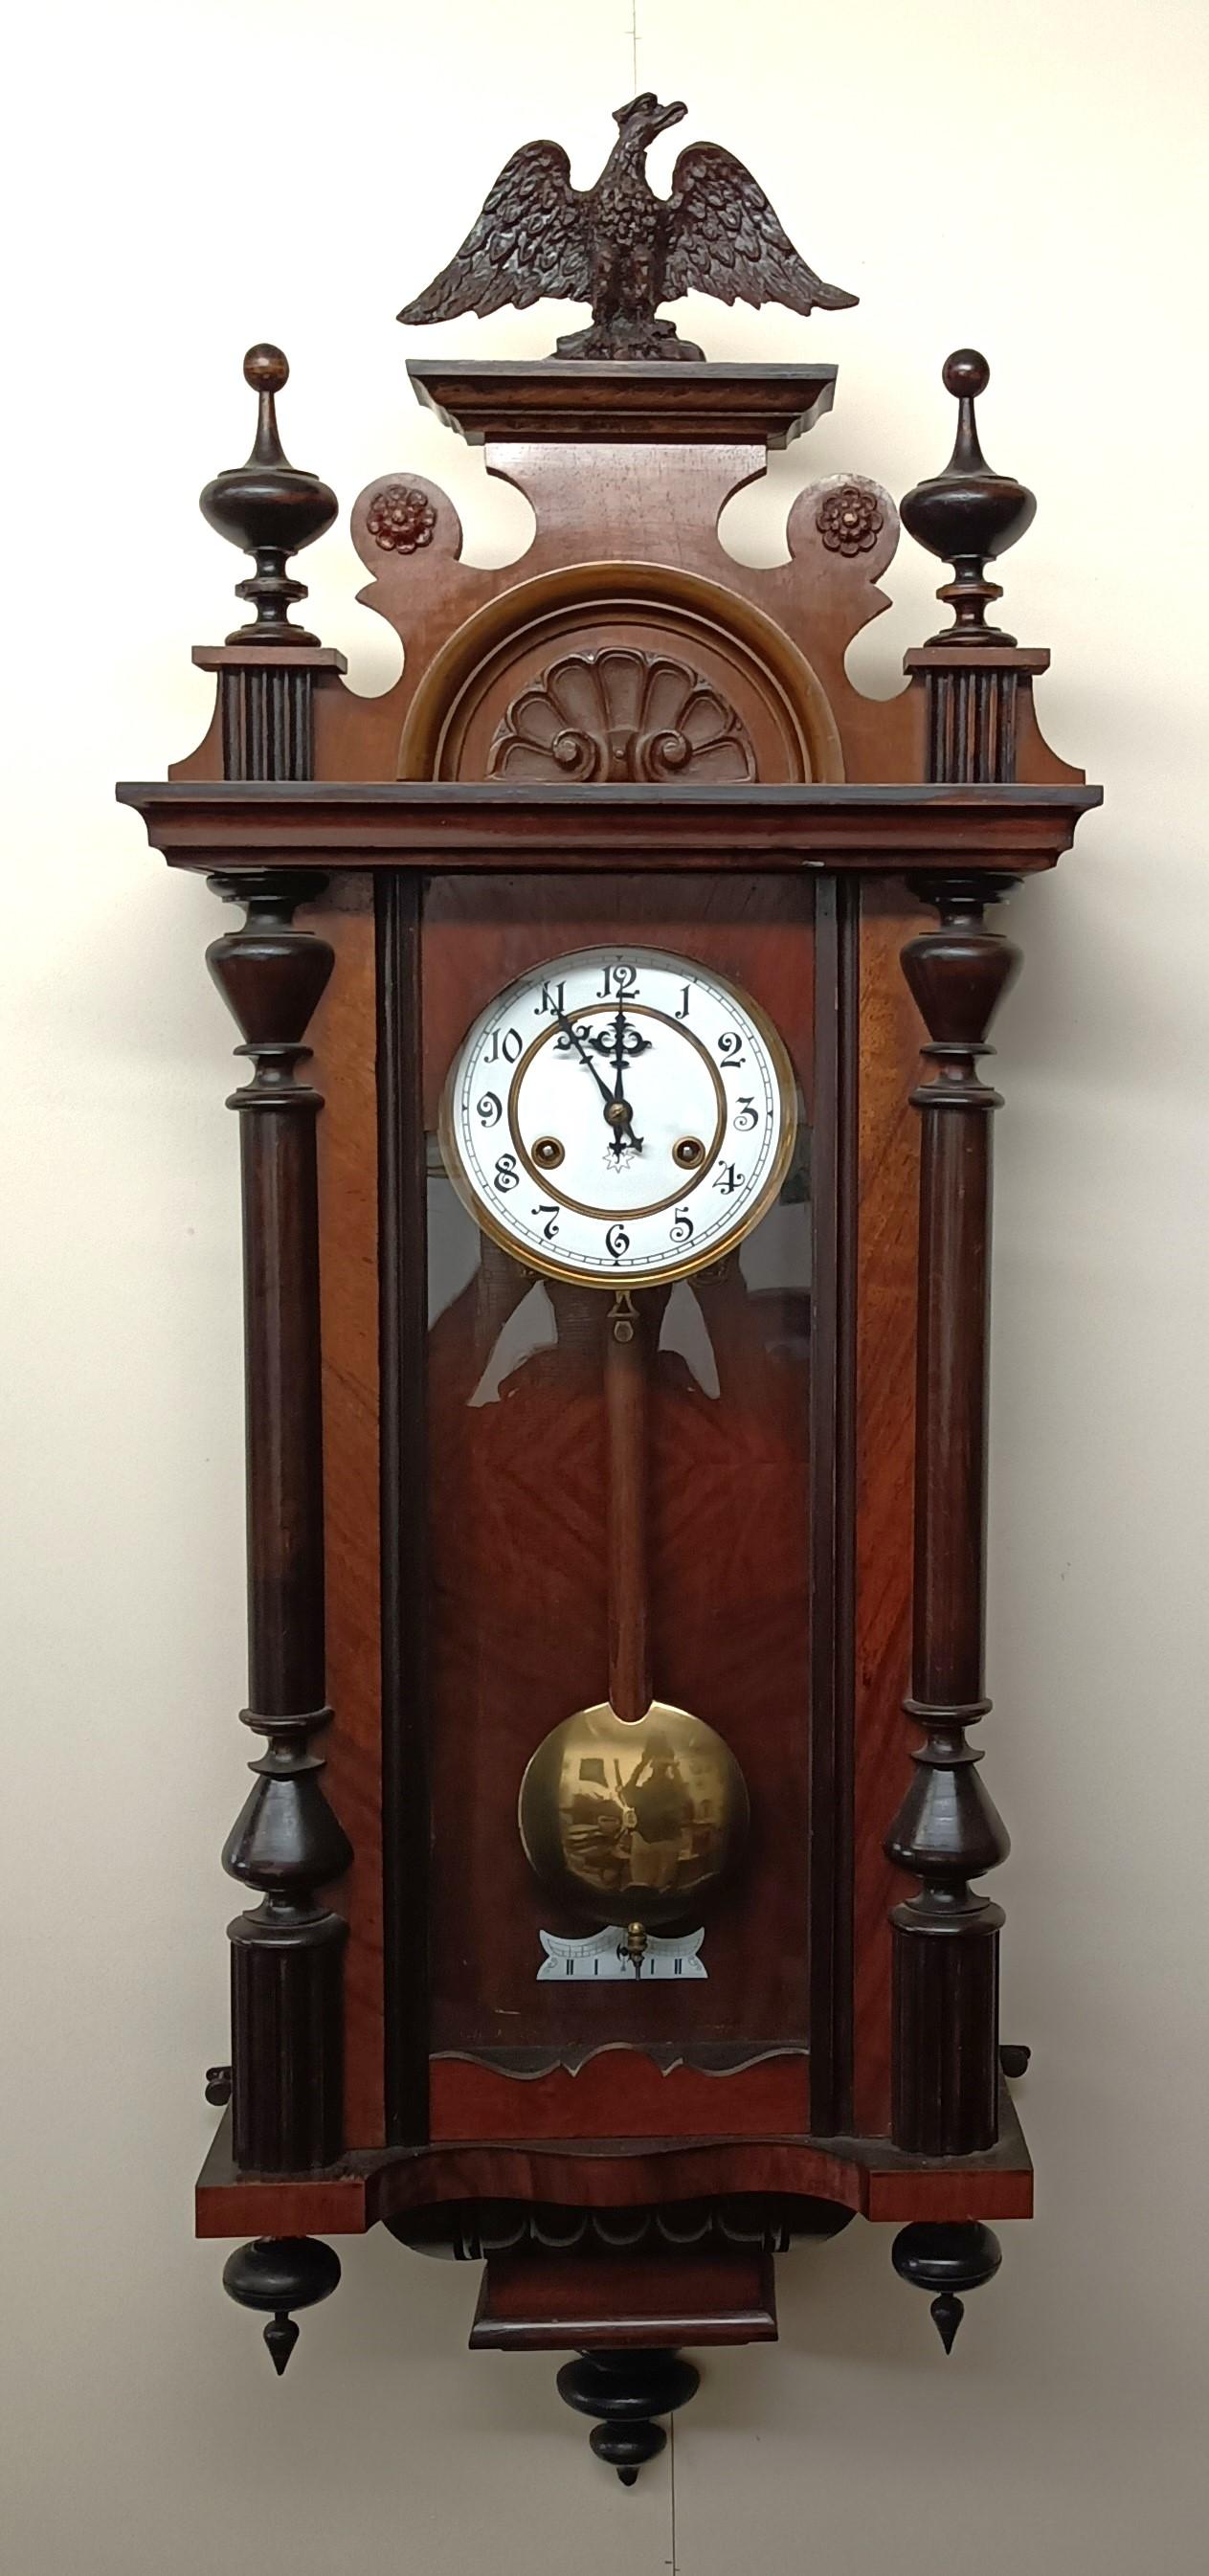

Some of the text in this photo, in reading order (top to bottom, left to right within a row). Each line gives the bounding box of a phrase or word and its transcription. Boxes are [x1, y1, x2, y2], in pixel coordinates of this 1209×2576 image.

[596, 964, 639, 998] 12
[675, 984, 690, 1019] 1
[483, 1027, 523, 1064] 10
[717, 1032, 746, 1067] 2
[477, 1091, 503, 1128] 9
[733, 1096, 759, 1131] 3
[494, 1153, 520, 1193] 8
[712, 1160, 745, 1195] 4
[531, 1205, 560, 1240] 7
[669, 1206, 694, 1242] 5
[605, 1224, 630, 1258] 6
